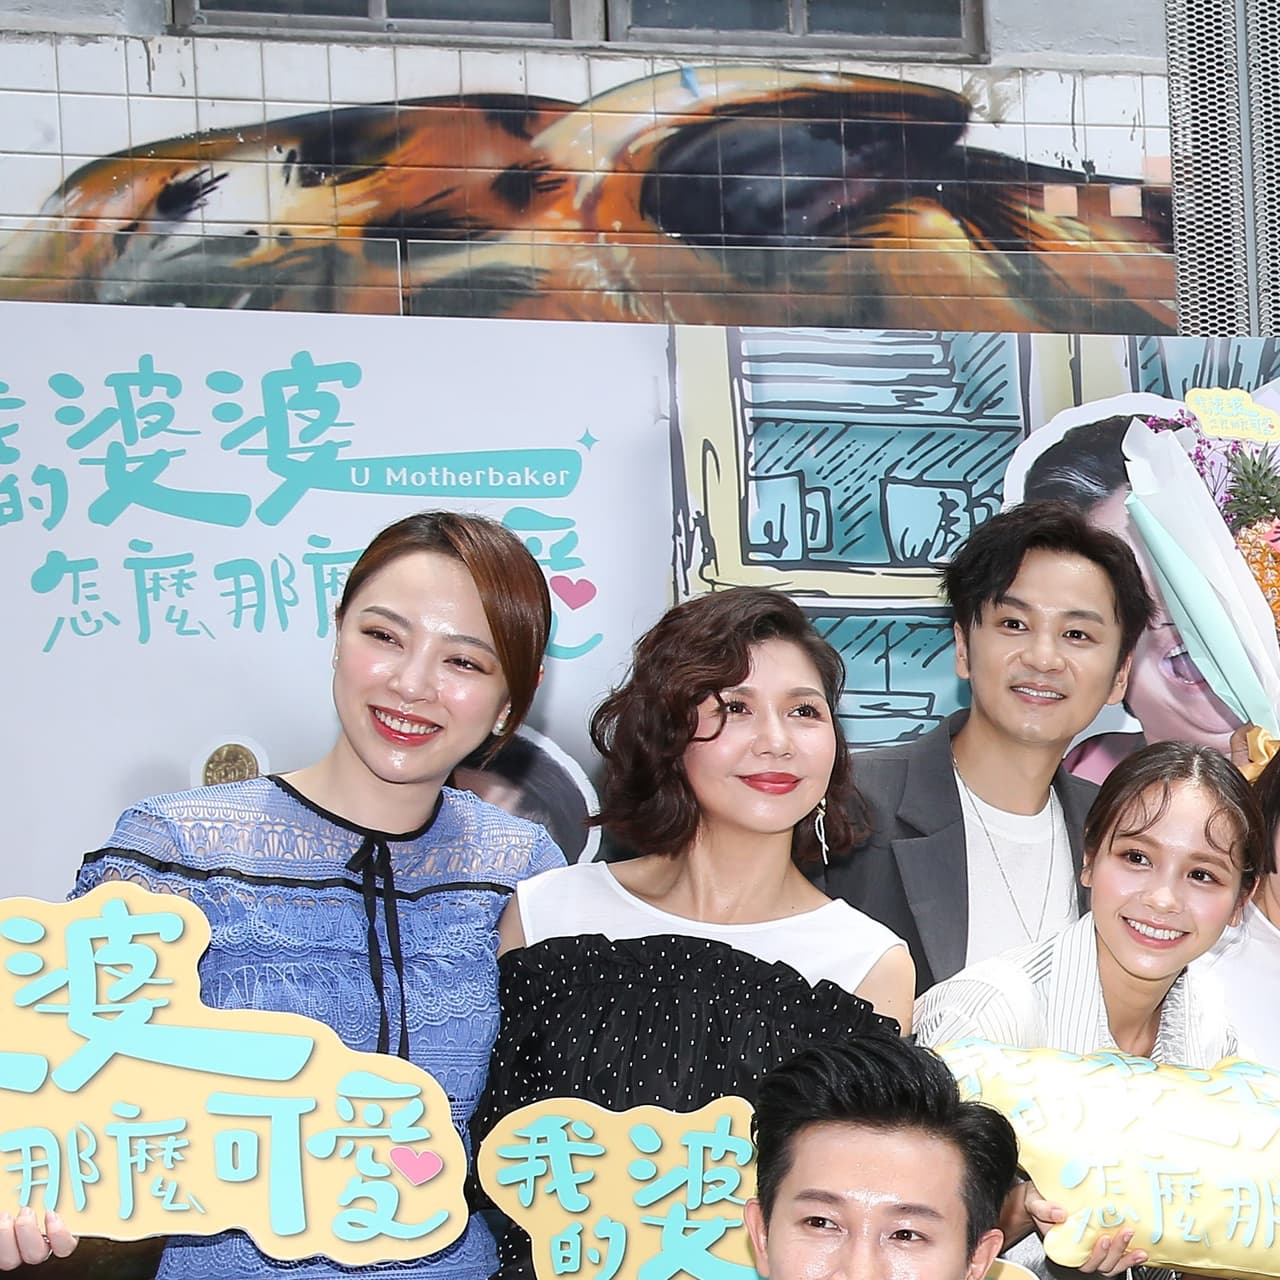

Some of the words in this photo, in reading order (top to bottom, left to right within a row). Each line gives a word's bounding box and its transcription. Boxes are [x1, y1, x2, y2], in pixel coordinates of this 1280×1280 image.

[350, 466, 371, 486] U
[386, 466, 571, 487] Motherbaker
[0, 898, 314, 1093] 婆
[0, 1071, 450, 1242] 那麼可愛
